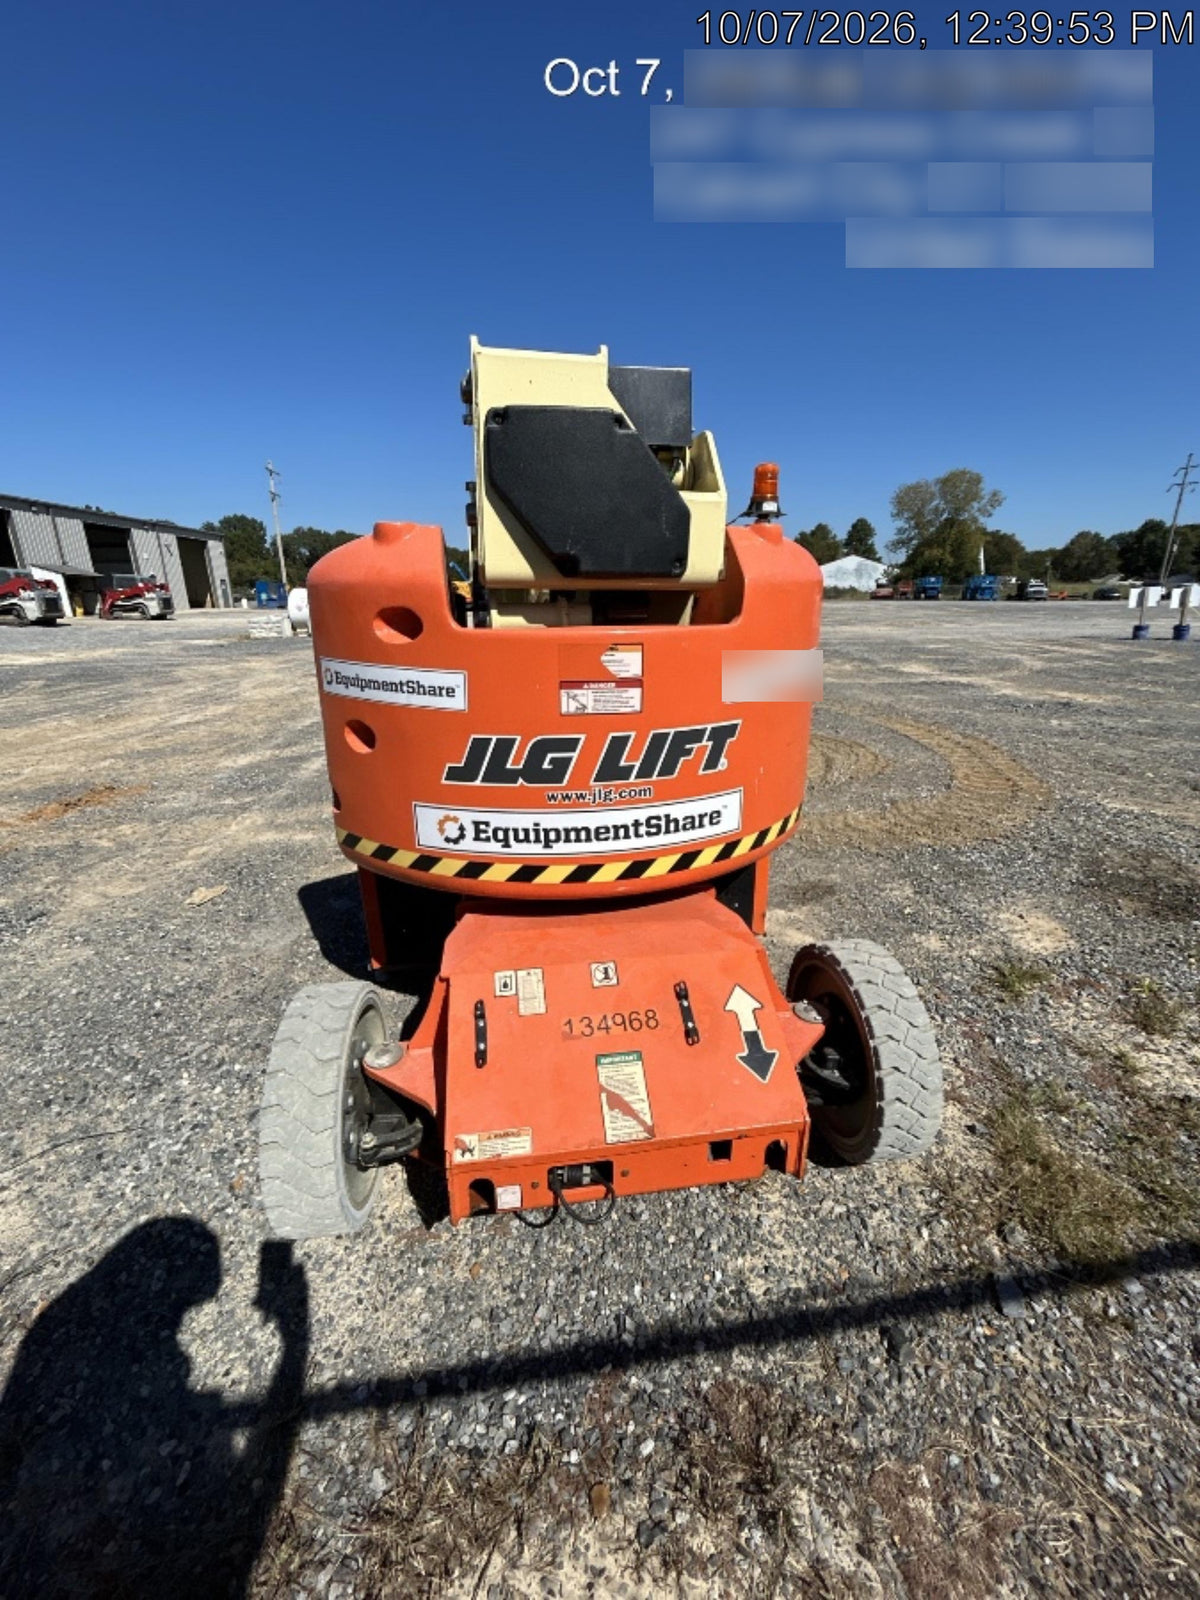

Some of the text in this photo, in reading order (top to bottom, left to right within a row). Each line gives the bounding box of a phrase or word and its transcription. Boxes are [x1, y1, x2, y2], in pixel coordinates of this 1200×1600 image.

[334, 670, 456, 699] EquipmentShare
[442, 719, 742, 786] JLG LIFT
[545, 786, 653, 804] www.jlg.com
[471, 807, 723, 847] EquipmentShare
[564, 1009, 660, 1037] 134968
